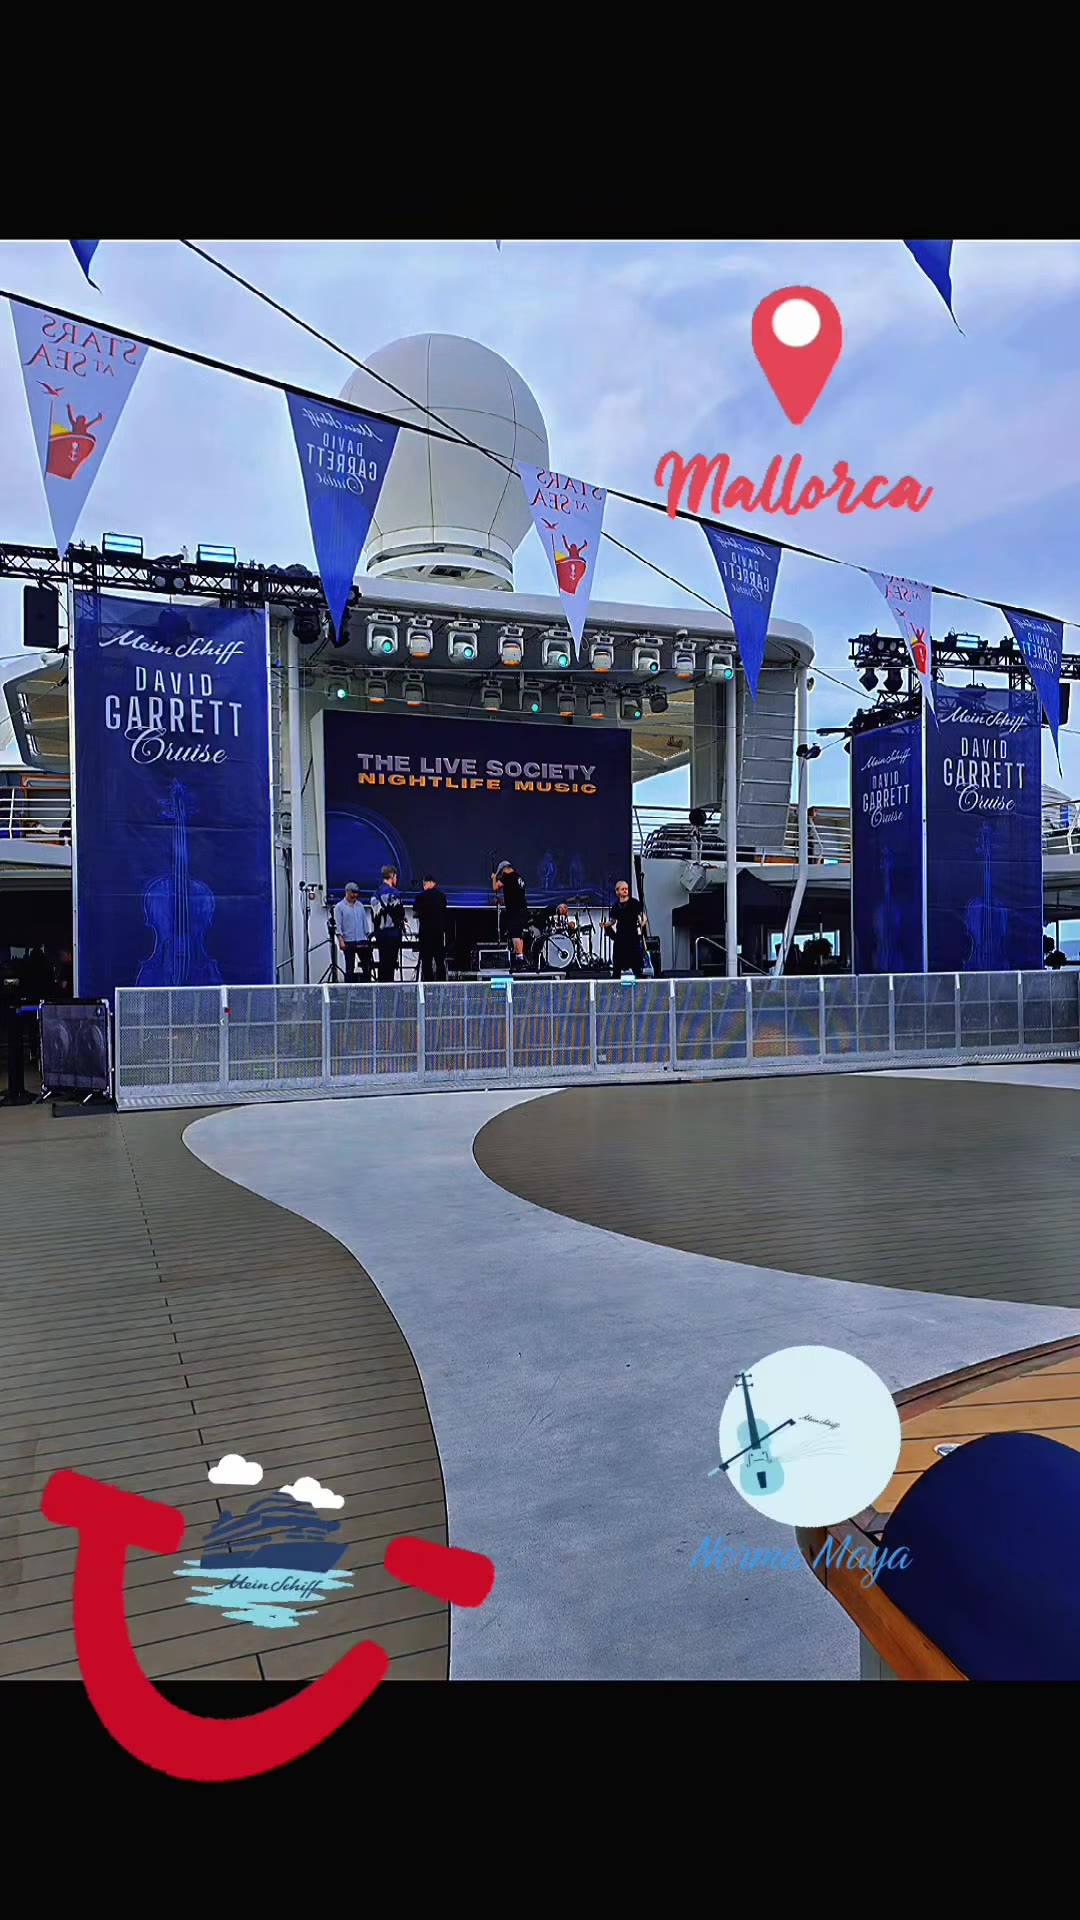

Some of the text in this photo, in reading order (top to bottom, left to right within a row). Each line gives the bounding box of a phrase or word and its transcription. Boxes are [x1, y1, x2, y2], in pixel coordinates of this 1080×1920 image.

[98, 630, 244, 664] Mein Schiff
[135, 666, 212, 697] DAVID
[105, 695, 242, 737] GARRETT
[940, 706, 1027, 733] Mein Schiff
[124, 725, 228, 764] Cruise
[961, 737, 1007, 759] DAVID
[357, 753, 596, 781] THE LIVE SOCIETY
[872, 770, 899, 790] DAVID
[943, 758, 1025, 789] GARRETT
[358, 773, 597, 794] NIGHTLIFE MUSIC
[955, 783, 1016, 812] Cruise
[863, 784, 910, 812] GARRETT
